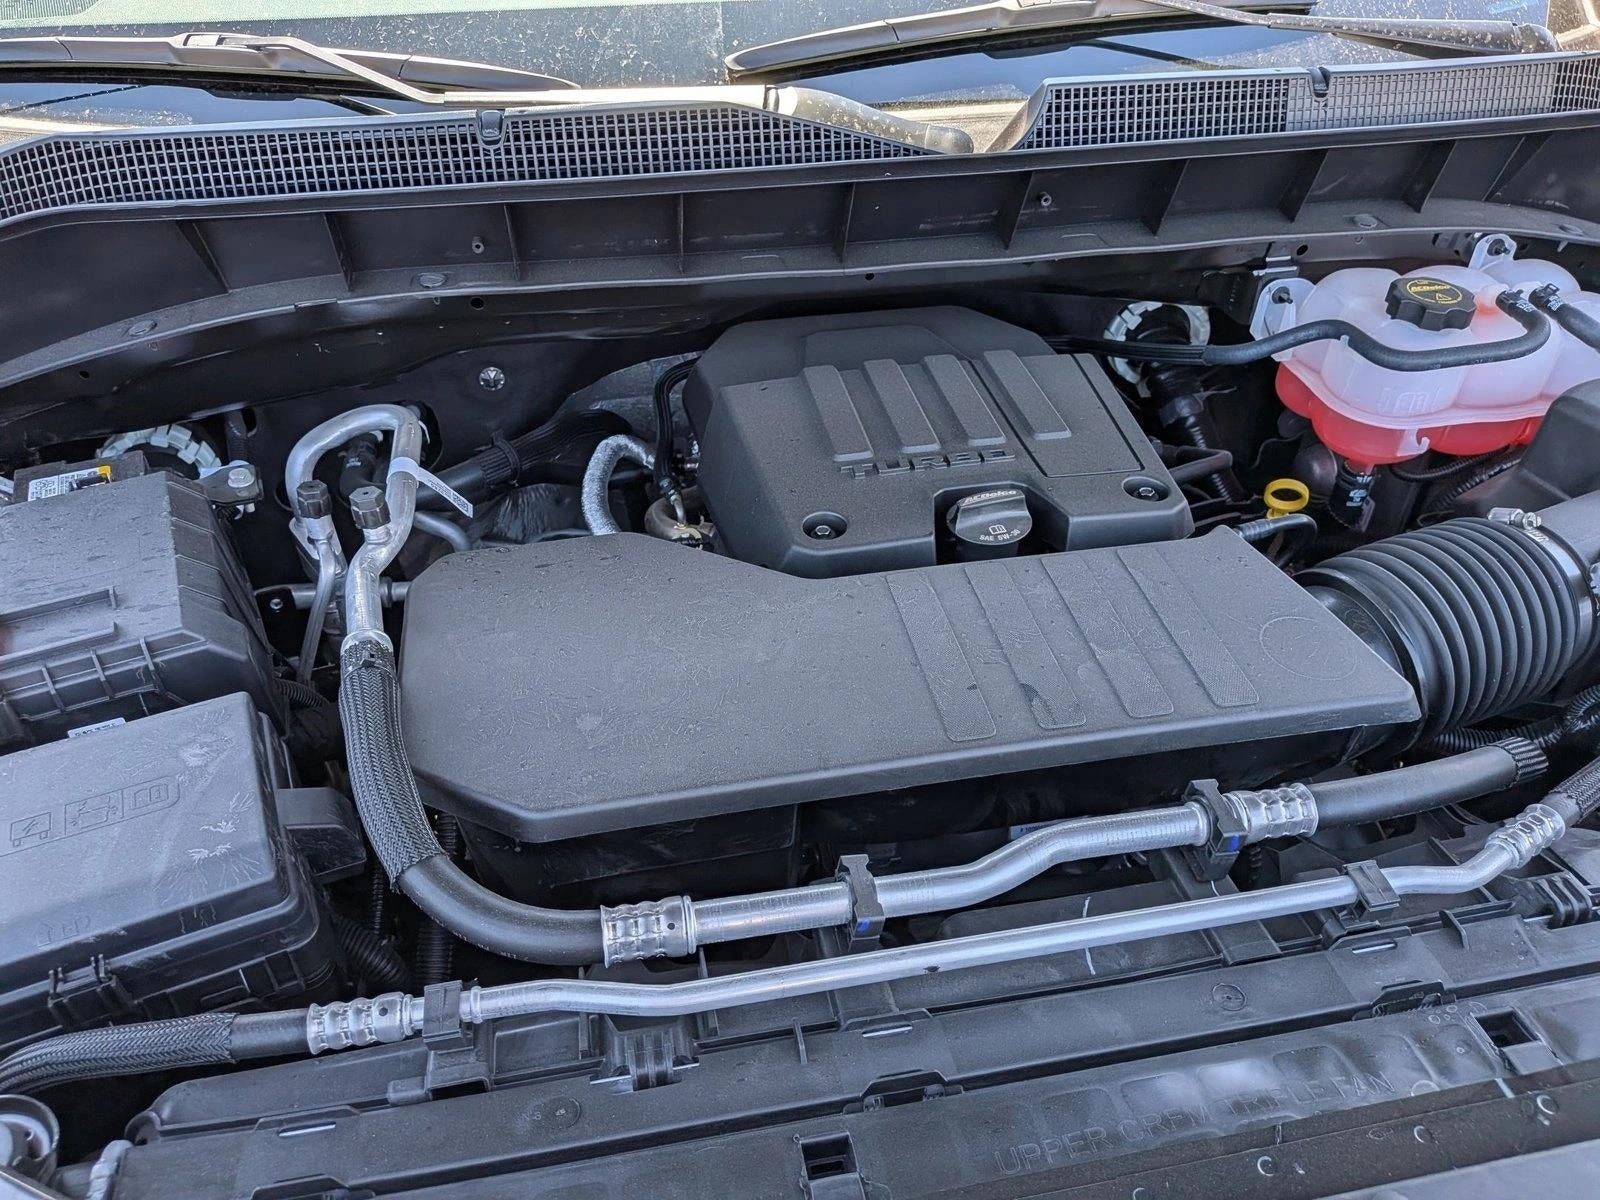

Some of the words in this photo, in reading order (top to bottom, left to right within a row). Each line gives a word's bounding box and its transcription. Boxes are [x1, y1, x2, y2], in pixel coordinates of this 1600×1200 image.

[840, 448, 1016, 479] TURBO
[995, 1127, 1113, 1175] UPPER
[1330, 1071, 1396, 1098] FAN
